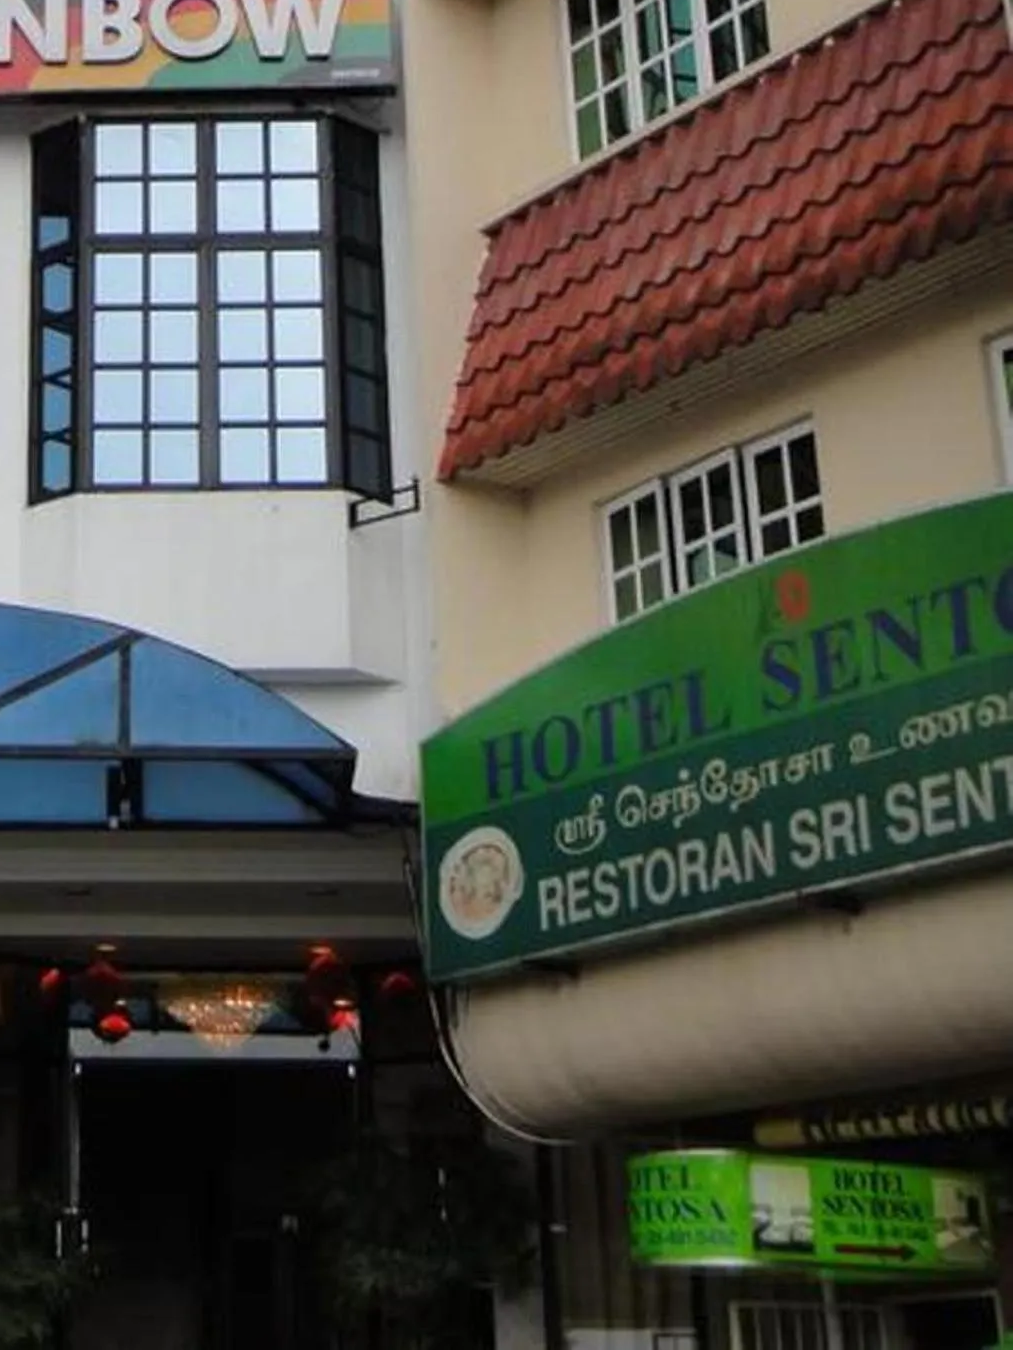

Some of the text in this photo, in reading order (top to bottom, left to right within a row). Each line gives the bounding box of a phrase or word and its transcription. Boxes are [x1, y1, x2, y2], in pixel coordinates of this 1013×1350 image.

[481, 668, 732, 802] HOTEL
[537, 820, 776, 932] RESTORAN
[789, 795, 871, 870] SRI
[832, 1167, 906, 1195] HOTEL
